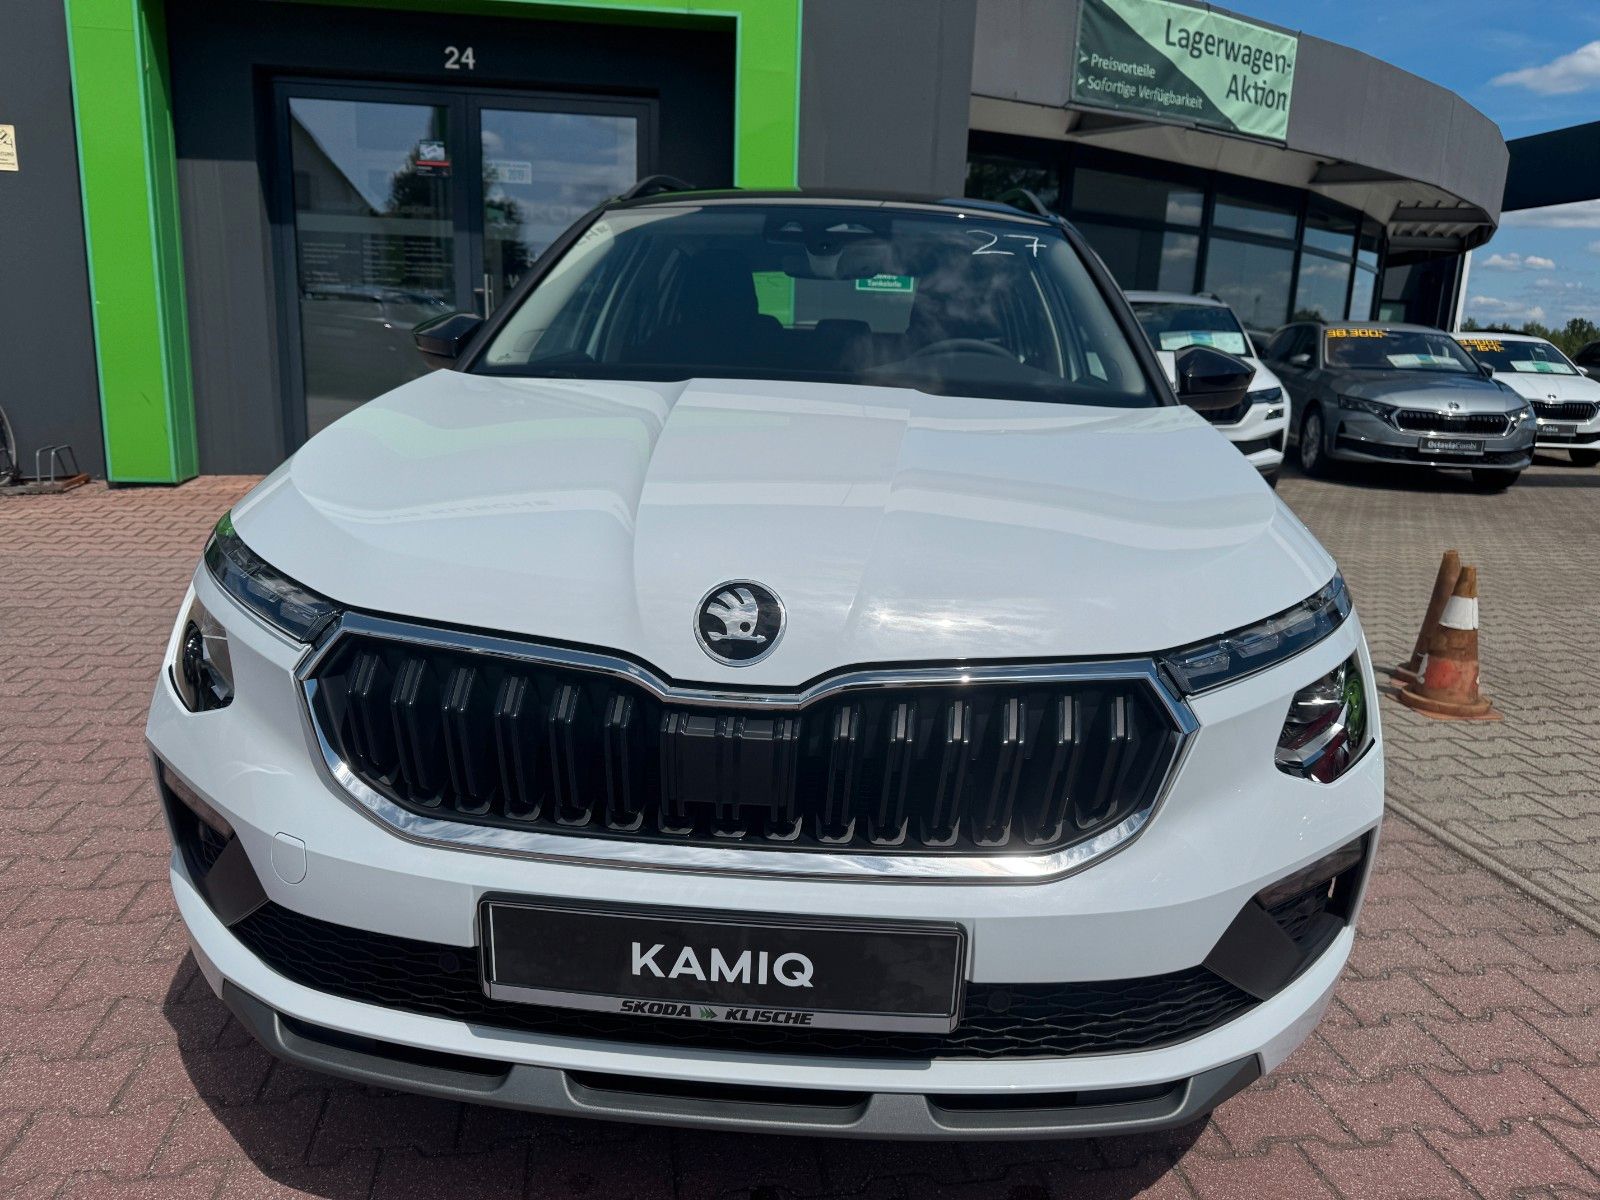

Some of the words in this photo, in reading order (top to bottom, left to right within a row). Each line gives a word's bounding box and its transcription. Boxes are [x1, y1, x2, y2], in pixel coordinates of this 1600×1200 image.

[444, 46, 476, 70] 24
[1165, 18, 1292, 75] Lagerwagen-
[1091, 53, 1156, 79] Preisvorteile
[1087, 75, 1137, 99] Sofortige
[1138, 84, 1203, 110] Verfügbarkeit
[1225, 73, 1288, 112] Aktion
[966, 229, 1047, 258] 27
[631, 941, 814, 988] KAMIQ
[724, 1008, 815, 1025] KLISCHE
